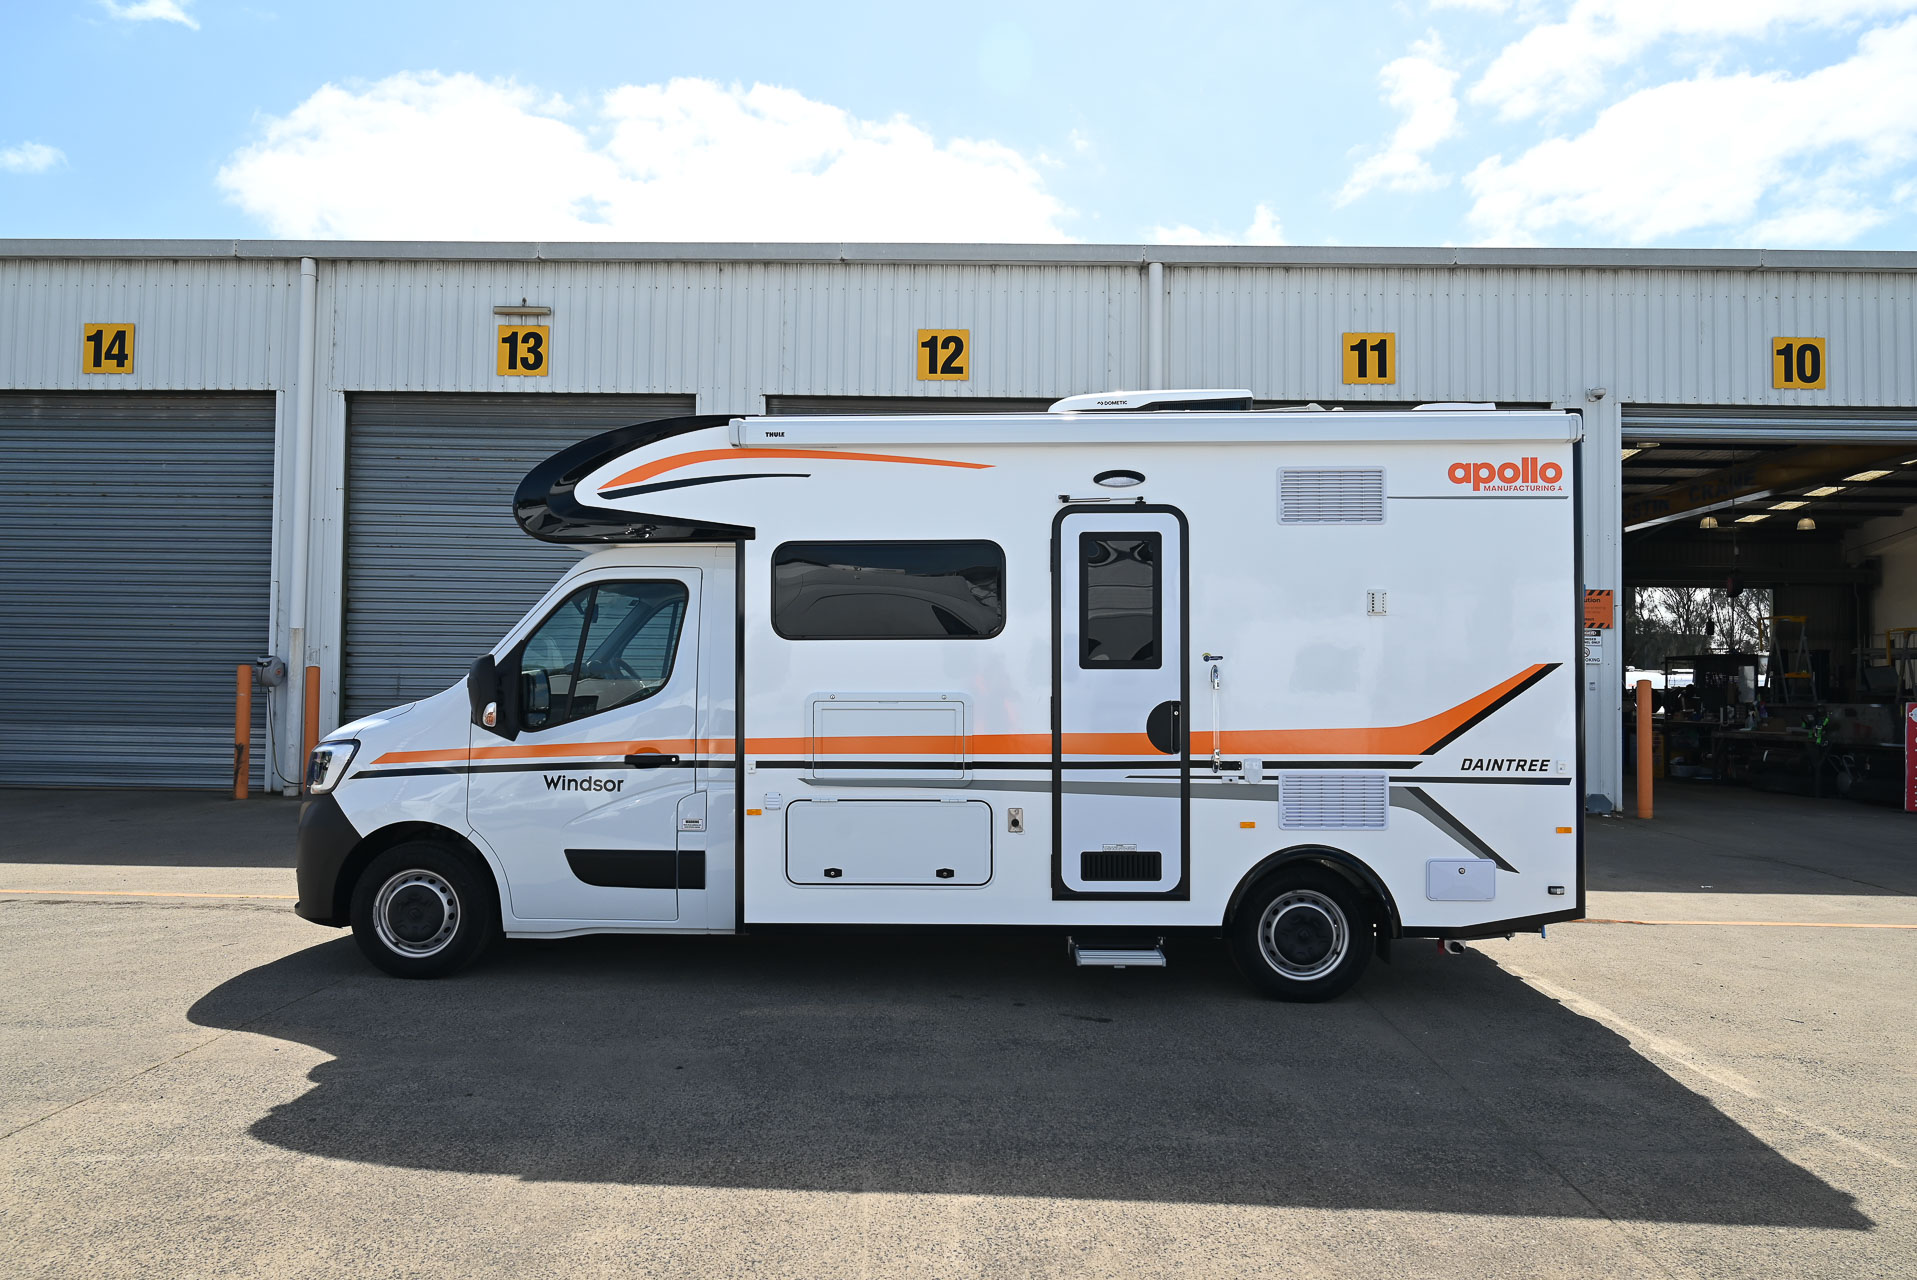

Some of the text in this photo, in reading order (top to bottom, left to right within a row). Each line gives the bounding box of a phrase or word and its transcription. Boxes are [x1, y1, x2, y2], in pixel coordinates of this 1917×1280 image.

[86, 329, 129, 368] 14
[501, 331, 544, 371] 13
[920, 335, 964, 375] 12
[1349, 338, 1388, 379] 11
[1775, 343, 1821, 384] 10
[1447, 456, 1563, 492] apollo
[1483, 484, 1556, 492] MANUFACTURING
[543, 774, 625, 793] Windsor
[1460, 758, 1551, 772] DAINTREE
